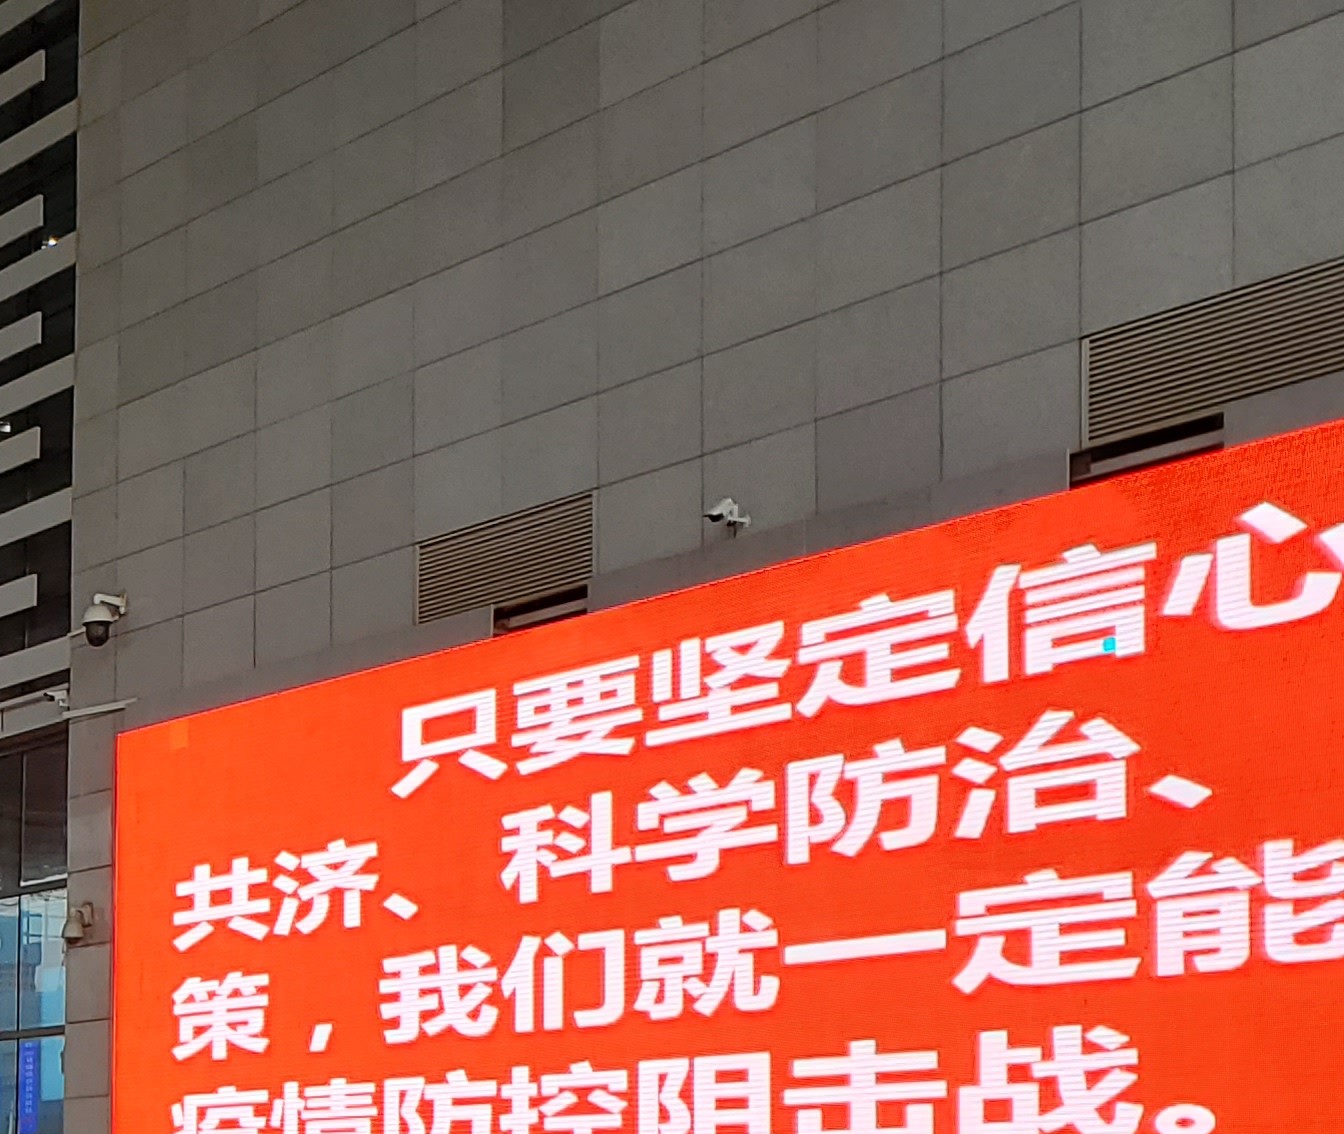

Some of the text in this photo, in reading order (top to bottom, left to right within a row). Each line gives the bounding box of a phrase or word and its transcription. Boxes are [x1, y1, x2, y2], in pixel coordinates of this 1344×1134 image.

[391, 500, 1344, 799] 只要坚定信心
[171, 837, 1344, 1061] 策，我们就一定能
